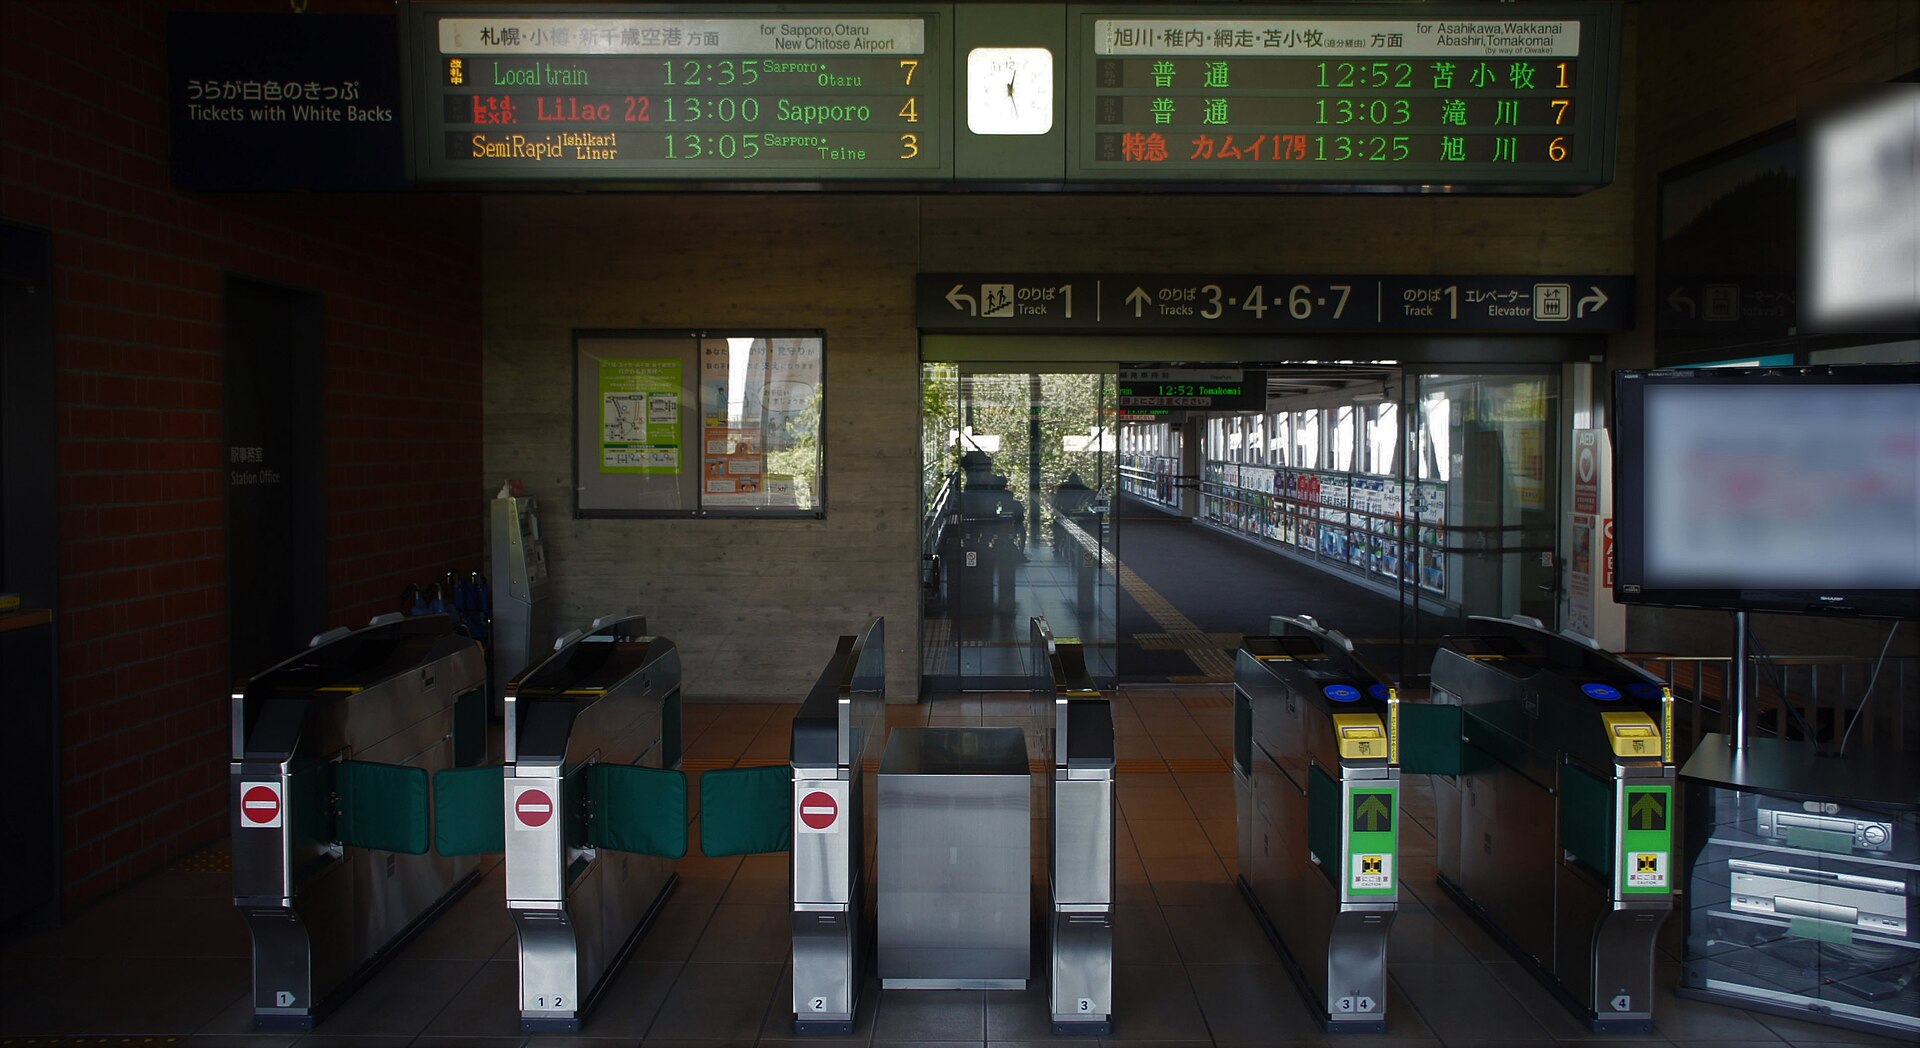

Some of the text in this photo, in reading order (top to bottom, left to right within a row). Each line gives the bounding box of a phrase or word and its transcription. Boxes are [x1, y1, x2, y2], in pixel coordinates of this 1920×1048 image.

[760, 24, 869, 38] for Sapporo,Otaru
[1417, 23, 1562, 35] for Asahikawa,Wakkanai
[687, 32, 719, 46] 方面
[775, 38, 894, 52] New Chitose Airport
[1114, 29, 1323, 47] 旭川・稚内・網走・苫小牧
[1371, 33, 1403, 48] 方面
[1437, 35, 1553, 48] Abashiri,Tomakomai
[1485, 47, 1496, 55] (by
[493, 60, 758, 86] Local train 12:35
[818, 59, 918, 87] Otaru 7
[1150, 61, 1569, 89] 普通 12:52 苫小牧 1
[187, 80, 360, 100] うらが白色のきっぷ
[473, 95, 517, 110] Ltd.
[187, 104, 392, 122] Tickets with White Backs
[473, 96, 917, 124] Exp. Lilac 22 13:00 Sapporo 4
[1150, 98, 1569, 126] 普通 13:03 滝川 7
[563, 133, 616, 146] Ishikari
[818, 133, 919, 160] Teine 3
[577, 134, 759, 160] Liner 13:05
[1122, 132, 1168, 162] 特急
[1315, 136, 1409, 161] 13:25
[1440, 136, 1517, 162] 旭川
[1549, 136, 1566, 162] 6
[1017, 284, 1072, 318] のりば 1
[1158, 287, 1196, 301] のりば
[1018, 303, 1047, 315] Track
[1403, 285, 1530, 319] のりば 1 エレベーター
[1159, 303, 1193, 317] Tracks
[1403, 304, 1433, 317] Track
[1488, 304, 1530, 317] Elevator
[1158, 385, 1241, 396] 12:52 Tomakomai
[1579, 433, 1594, 446] AED
[231, 470, 280, 486] Station Office
[281, 994, 286, 1003] 1
[538, 998, 562, 1007] 1 2
[815, 999, 823, 1009] 2
[1081, 1001, 1088, 1010] 3
[1343, 1000, 1368, 1009] 3 4
[1619, 999, 1626, 1008] 4
